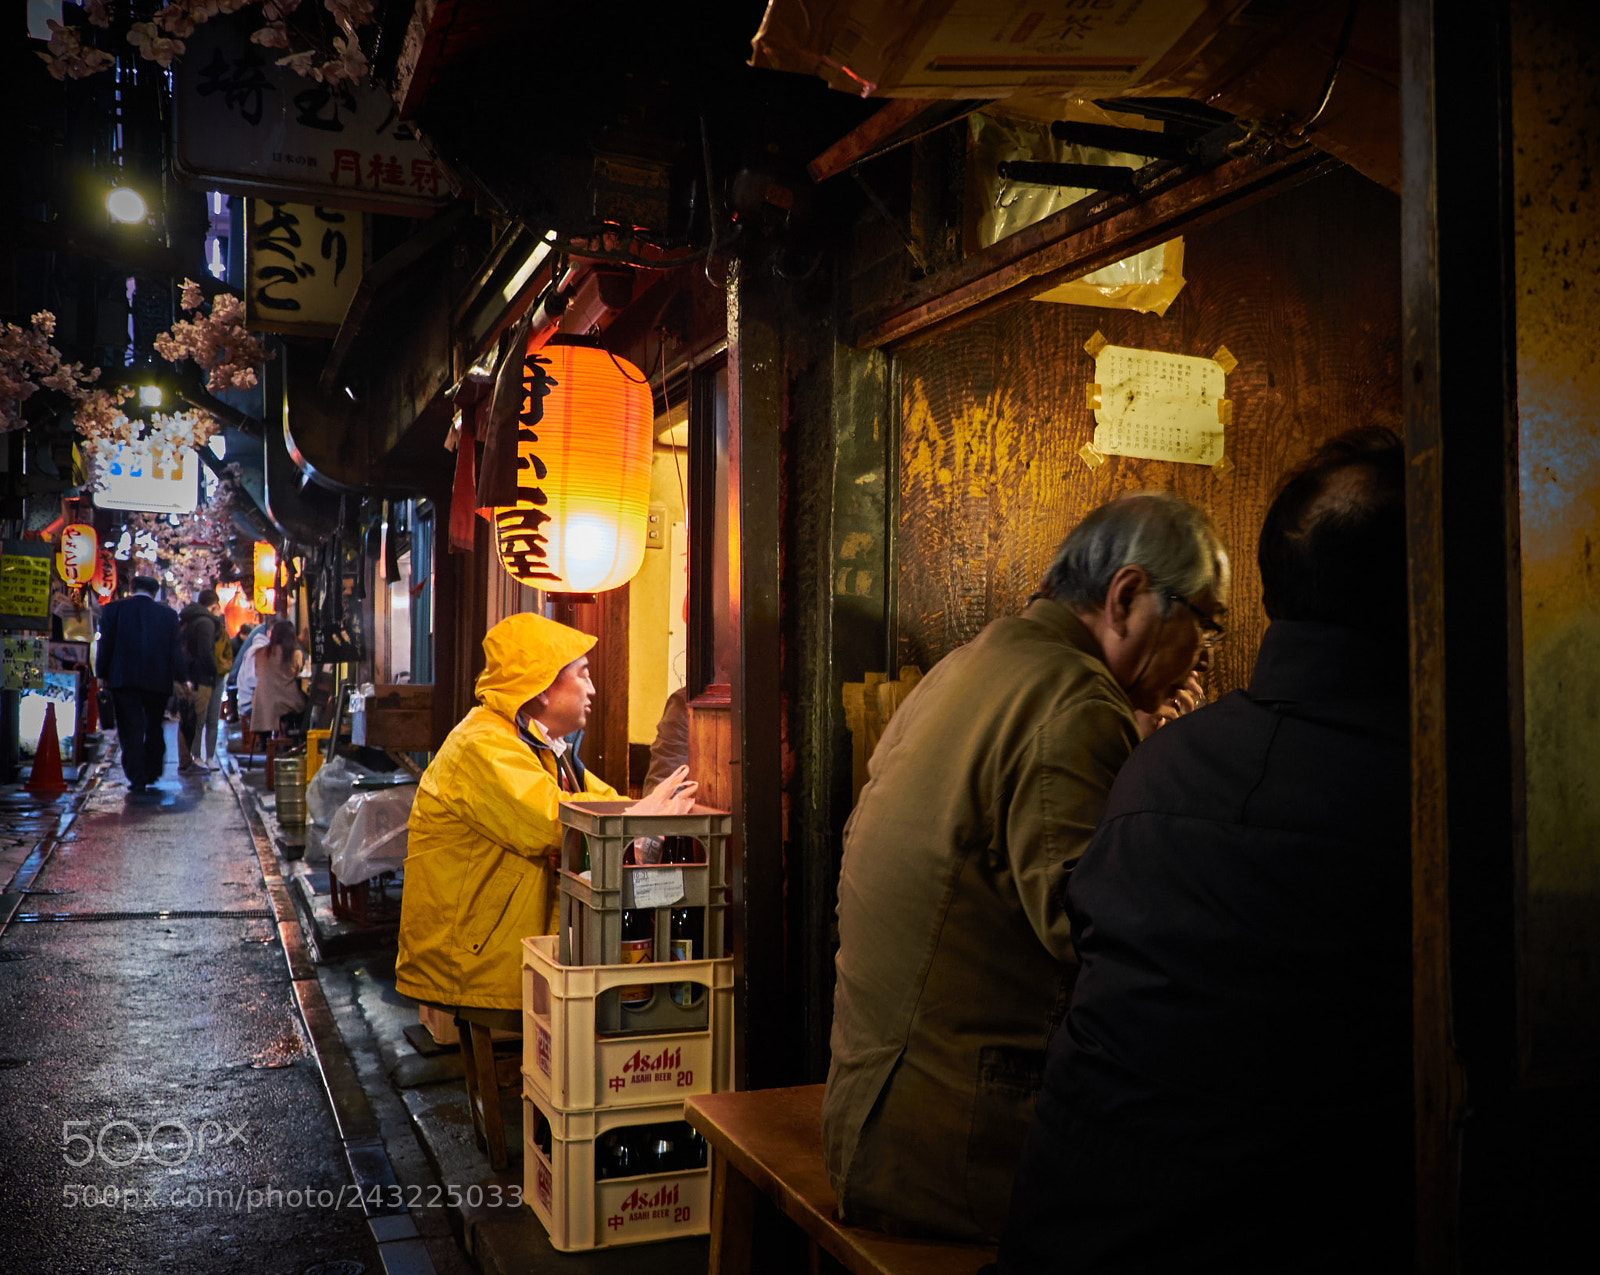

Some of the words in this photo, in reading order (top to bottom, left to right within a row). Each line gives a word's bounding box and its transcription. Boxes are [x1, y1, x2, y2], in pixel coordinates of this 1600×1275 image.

[330, 148, 442, 195] 月桂冠
[623, 1047, 681, 1073] Asahi
[609, 1076, 626, 1093] 中
[631, 1073, 652, 1084] ASAHI
[654, 1072, 672, 1082] BEER
[677, 1070, 693, 1087] 20
[621, 1184, 679, 1212] Asahi
[608, 1214, 624, 1231] 中
[629, 1211, 650, 1222] ASAHI
[652, 1209, 670, 1219] BEER
[674, 1206, 691, 1224] 20
